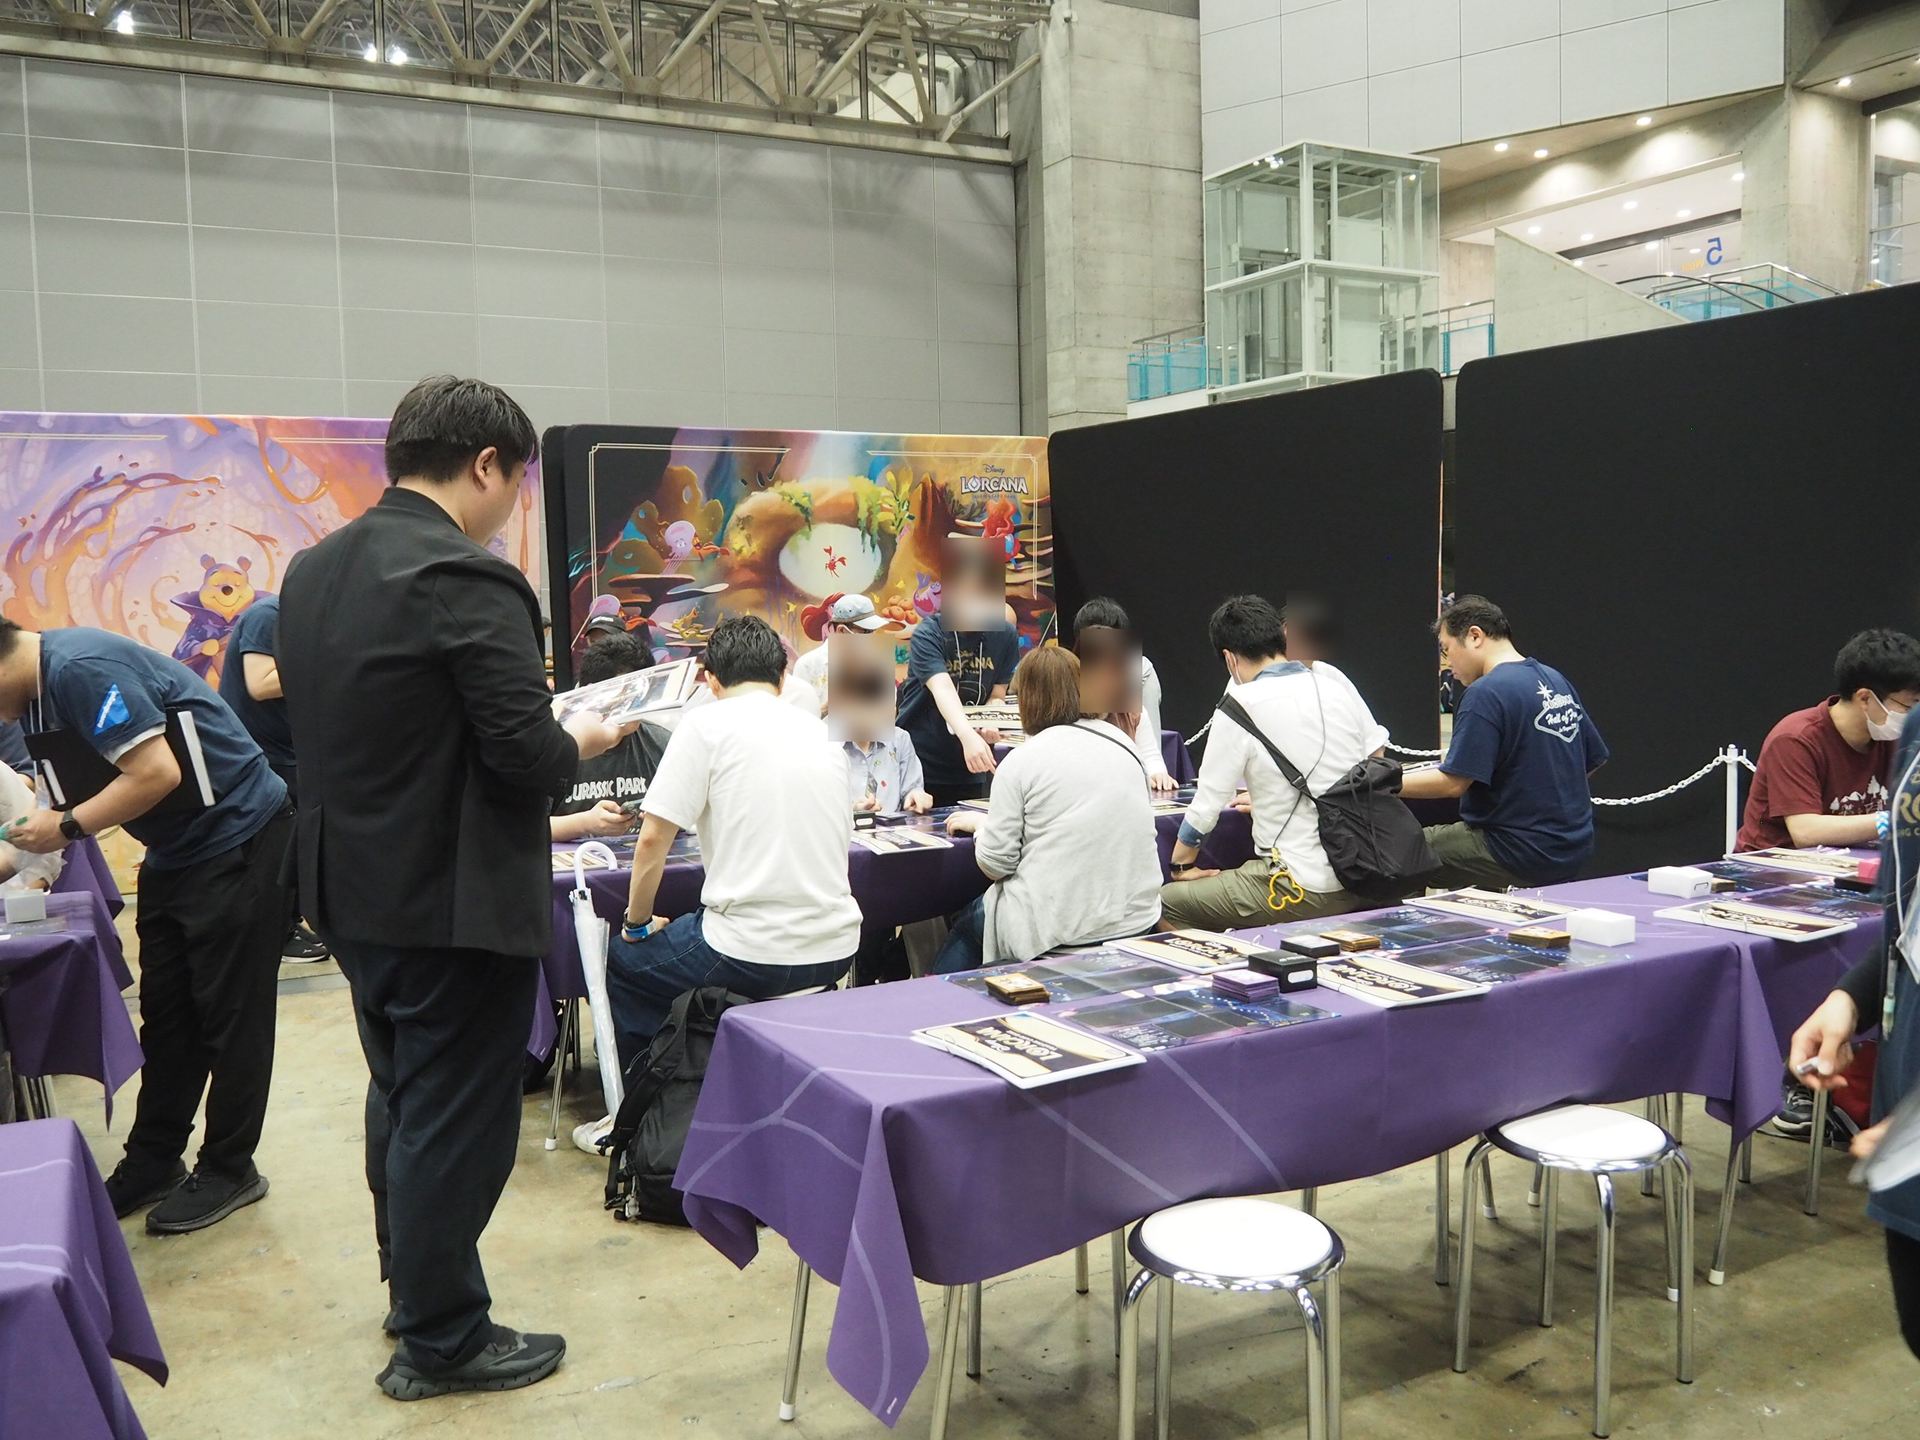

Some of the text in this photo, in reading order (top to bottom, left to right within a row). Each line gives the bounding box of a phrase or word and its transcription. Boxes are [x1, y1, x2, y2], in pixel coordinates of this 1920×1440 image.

[983, 463, 1005, 475] Disney
[960, 476, 1028, 495] LORCANA
[565, 777, 648, 803] JURASSIC PARK
